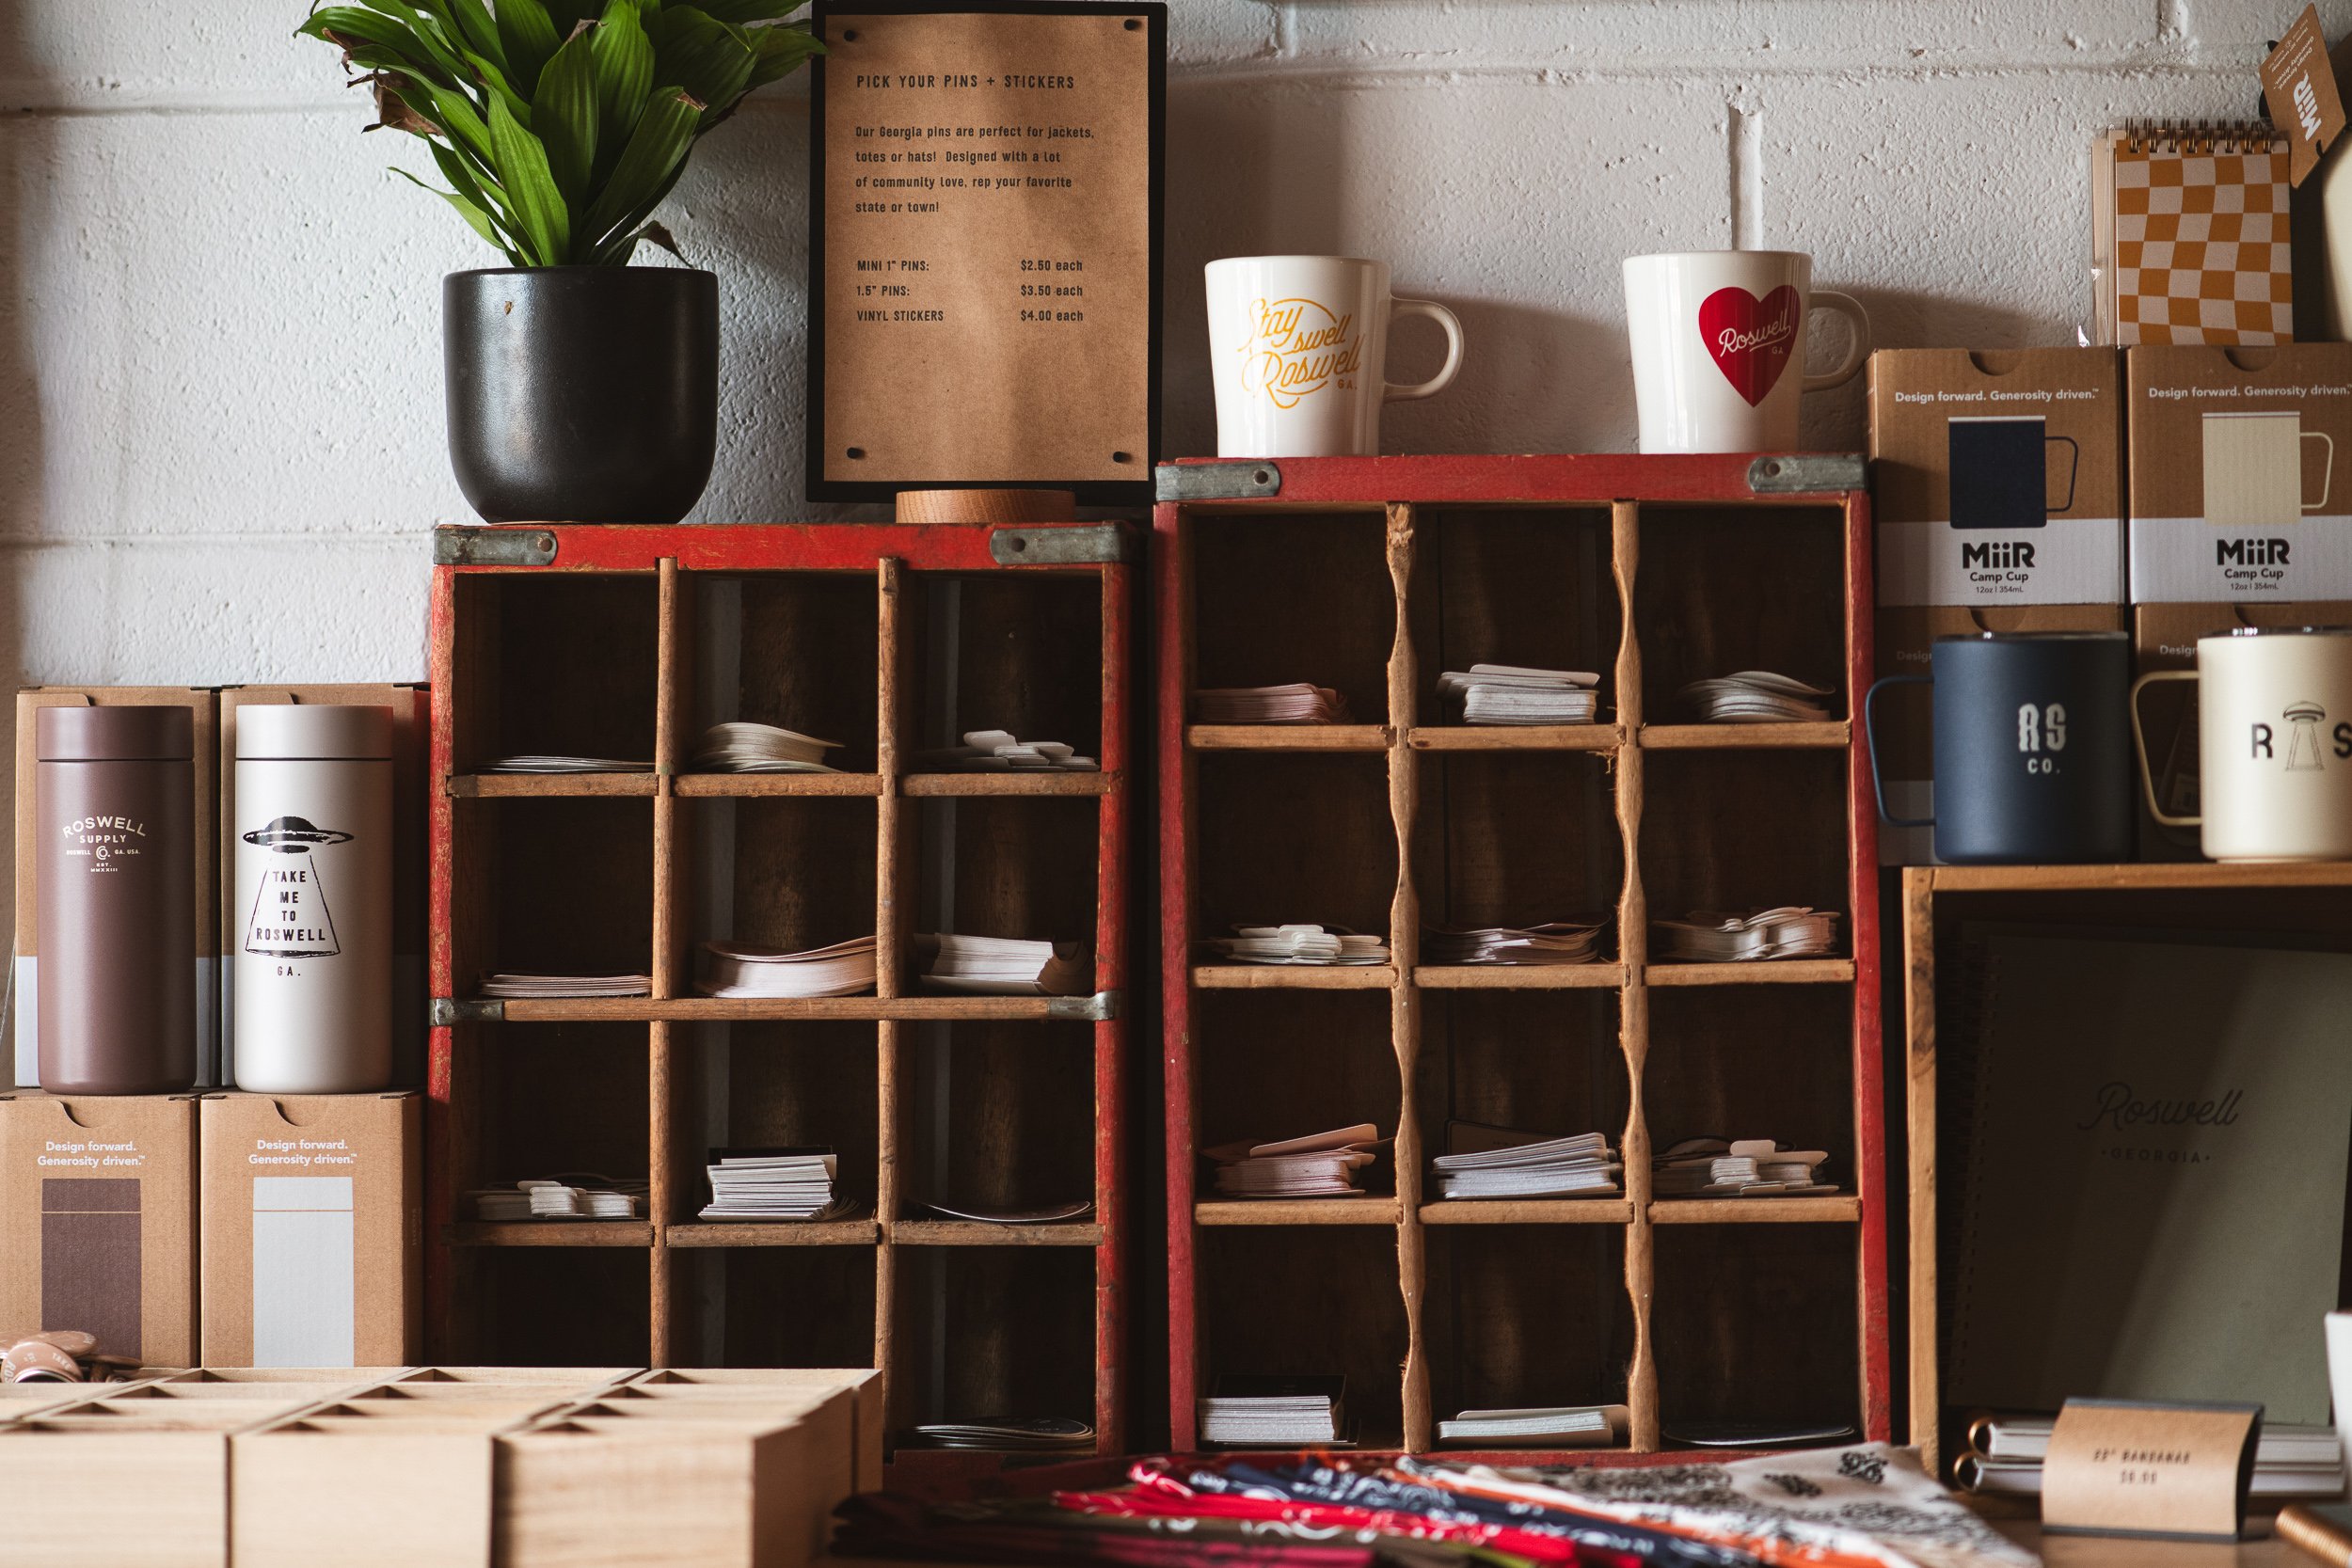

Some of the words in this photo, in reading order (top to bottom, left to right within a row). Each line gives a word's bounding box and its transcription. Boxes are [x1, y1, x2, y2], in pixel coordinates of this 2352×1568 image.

[857, 75, 890, 88] PICK
[899, 75, 935, 88] YOUR
[944, 75, 978, 88] PINS
[987, 77, 995, 86] +
[1005, 76, 1075, 89] STICKERS
[856, 126, 874, 137] Our
[880, 126, 922, 140] Georgia
[927, 126, 951, 139] pins
[956, 128, 974, 137] are
[979, 126, 1022, 139] perfect
[1027, 126, 1043, 137] for
[1047, 126, 1094, 139] jackets,
[856, 151, 886, 162] totes
[891, 153, 904, 162] or
[908, 151, 936, 162] hats!
[946, 151, 996, 165] Designed
[1002, 151, 1028, 162] with
[1033, 153, 1039, 162] a
[1044, 151, 1061, 163] lot
[856, 176, 868, 187] of
[873, 176, 935, 190] community
[940, 176, 967, 188] love,
[972, 179, 990, 189] rep
[996, 179, 1021, 190] your
[1026, 176, 1072, 188] favorite
[856, 202, 885, 212] state
[891, 203, 903, 212] or
[908, 201, 939, 212] town!
[857, 261, 882, 271] MINI
[901, 260, 929, 271] PINS:
[1020, 260, 1051, 271] $2.50
[1056, 260, 1082, 271] each
[882, 285, 910, 296] PINS:
[1020, 285, 1051, 296] $3.50
[1056, 285, 1082, 296] each
[857, 311, 888, 321] VINYL
[894, 311, 944, 321] STICKERS
[1020, 310, 1051, 321] $4.00
[1056, 310, 1083, 321] each
[1237, 298, 1303, 352] Stay
[1282, 313, 1352, 356] swell
[1718, 308, 1791, 357] Roswell
[1242, 332, 1364, 409] Roswell
[1895, 391, 1934, 404] Design
[1937, 390, 1987, 402] forward.
[1990, 389, 2053, 403] Generosity
[2149, 387, 2188, 400] Design
[2192, 386, 2241, 398] forward.
[2244, 385, 2307, 399] Generosity
[1963, 542, 2035, 568] MiiR
[2217, 538, 2290, 565] MiiR
[1970, 572, 2002, 583] Camp
[2006, 571, 2029, 583] Cup
[2224, 568, 2257, 580] Camp
[2261, 568, 2284, 580] Cup
[62, 816, 146, 838] ROSWELL
[79, 835, 126, 844] SUPPLY
[273, 871, 306, 882] TAKE
[280, 892, 299, 903] ME
[282, 911, 296, 921] TO
[256, 927, 326, 941] ROSWELL
[278, 966, 301, 976] GA.
[2076, 1081, 2244, 1132] Roswell
[46, 1141, 85, 1153] Design
[88, 1141, 136, 1151] forward.
[257, 1139, 295, 1152] Design
[299, 1139, 348, 1149] forward.
[37, 1155, 99, 1168] Generosity
[248, 1153, 310, 1166] Generosity
